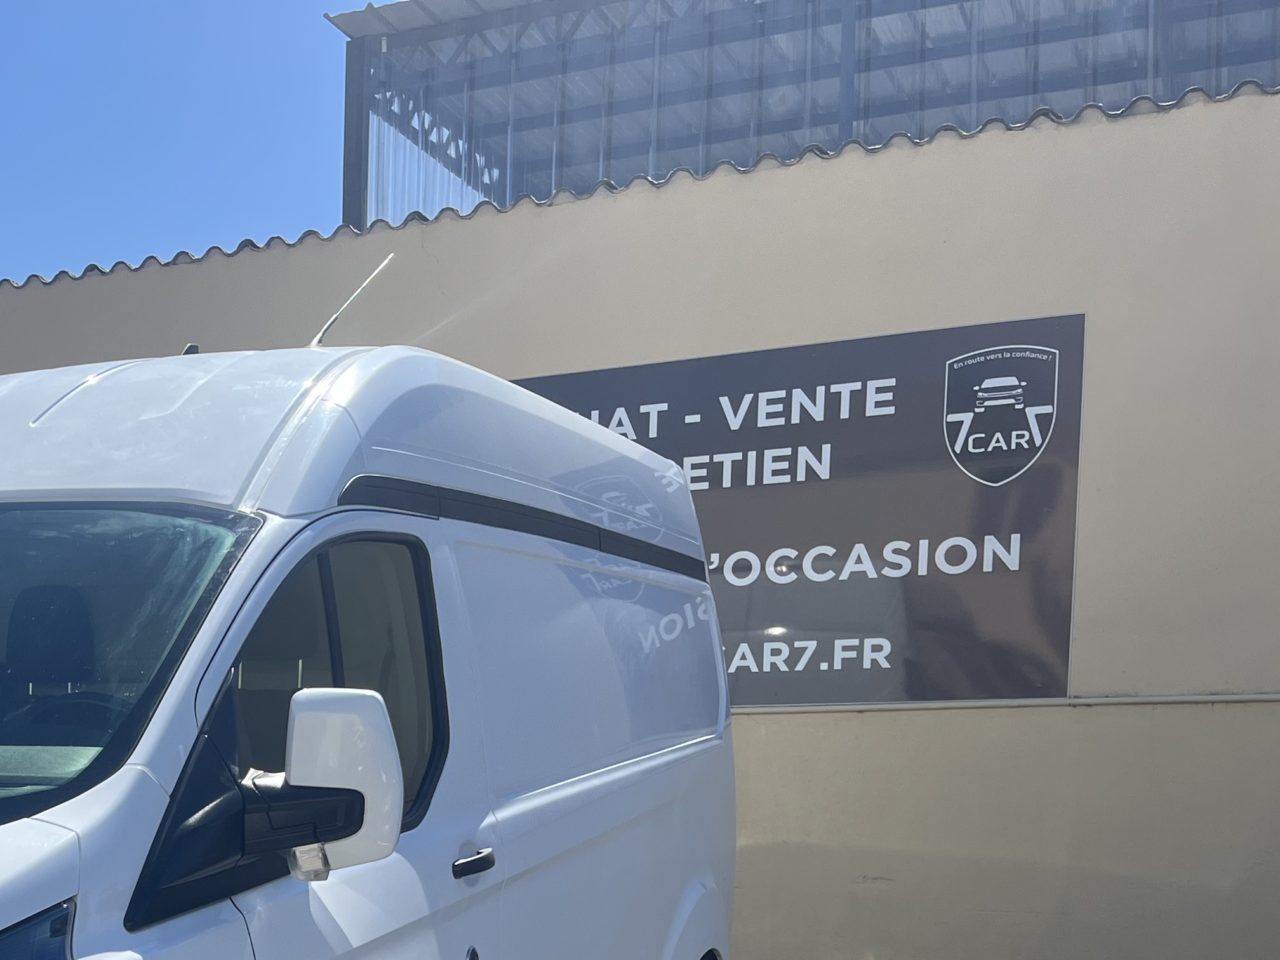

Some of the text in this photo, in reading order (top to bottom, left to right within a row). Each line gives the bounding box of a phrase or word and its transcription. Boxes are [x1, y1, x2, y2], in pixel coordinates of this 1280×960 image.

[964, 355, 985, 365] route
[986, 352, 1002, 361] vers
[1011, 351, 1048, 360] confiance
[718, 377, 897, 432] VENTE
[722, 637, 892, 674] AR7.FR
